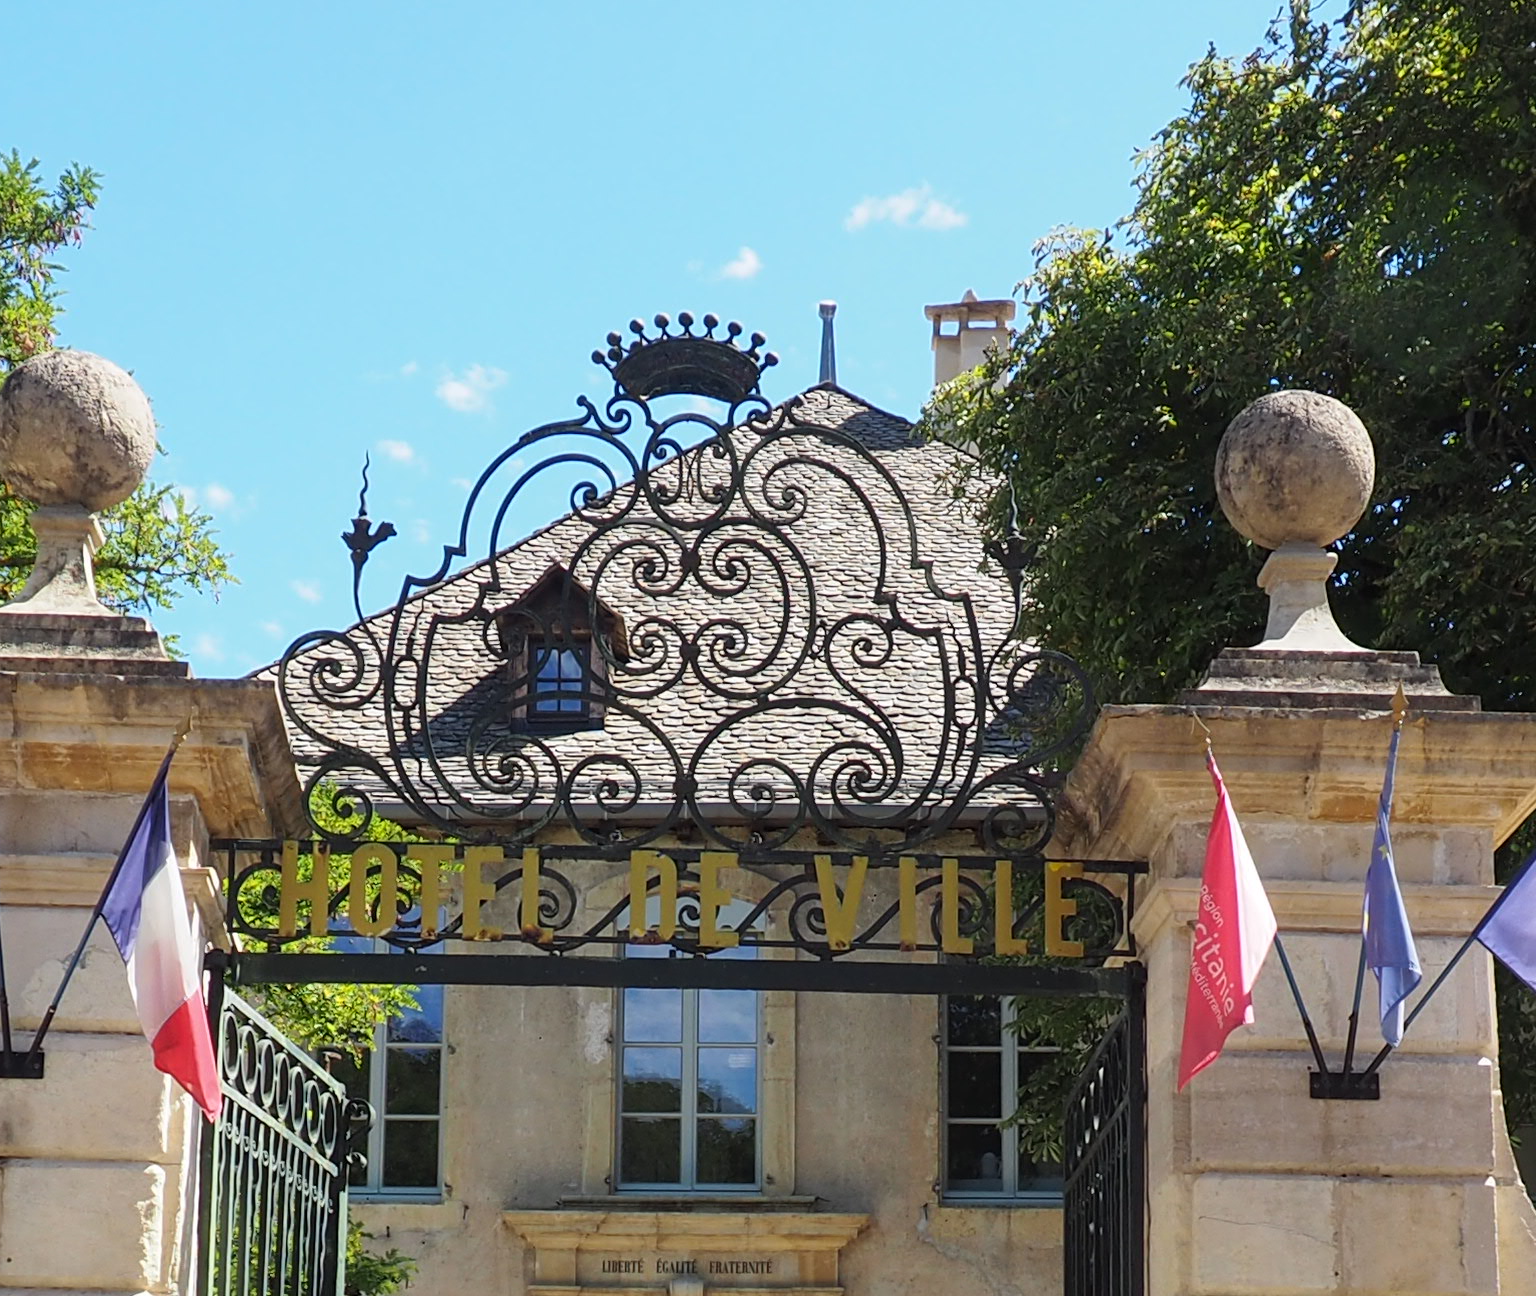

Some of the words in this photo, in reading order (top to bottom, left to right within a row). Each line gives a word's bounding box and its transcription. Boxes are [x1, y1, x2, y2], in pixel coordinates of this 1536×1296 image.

[279, 839, 553, 943] HOTEL
[630, 850, 740, 948] DE
[814, 853, 1085, 958] VILLE
[602, 1258, 644, 1274] LIBERTÉ
[656, 1258, 698, 1274] ÉGALITÉ
[709, 1258, 773, 1274] FRATERNITÉ
